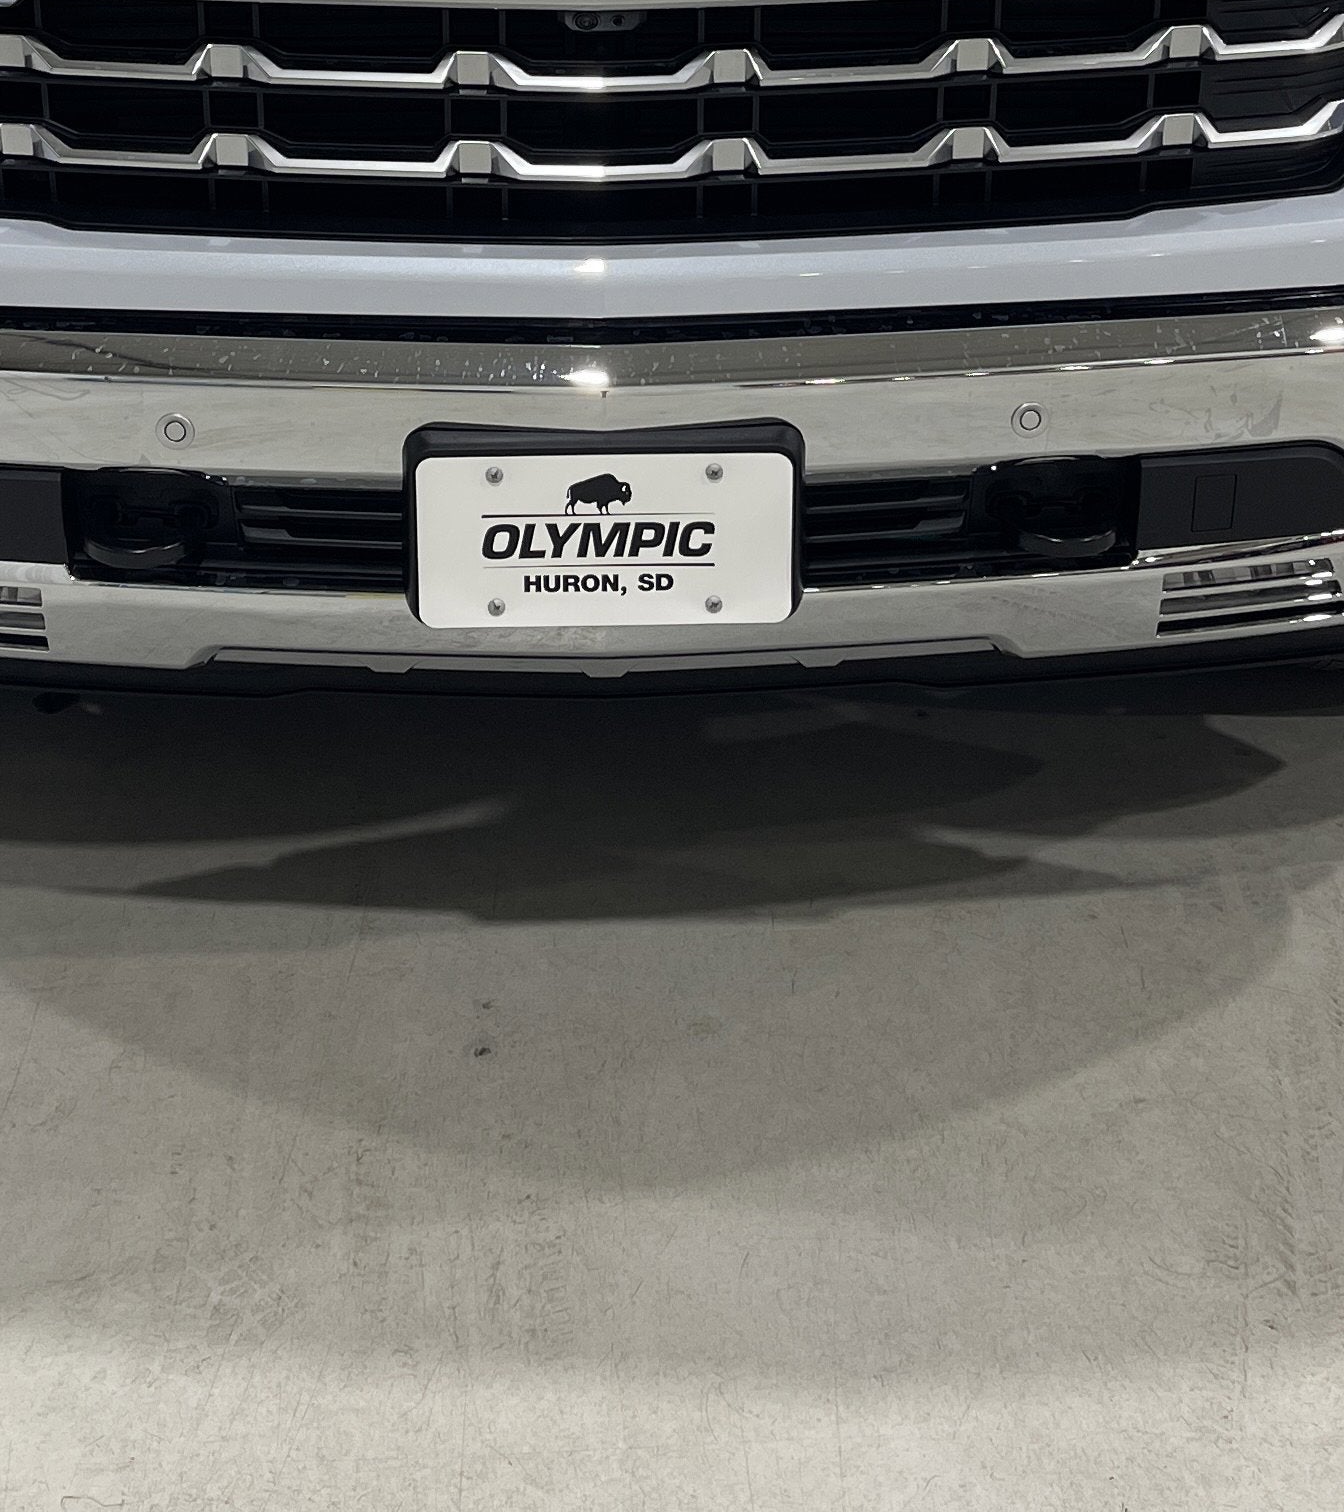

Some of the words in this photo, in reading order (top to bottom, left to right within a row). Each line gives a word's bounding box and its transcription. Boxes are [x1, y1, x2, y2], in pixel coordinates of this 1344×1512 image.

[482, 521, 715, 559] OLYMPIC
[524, 574, 627, 596] HURON,
[638, 573, 674, 591] SD
